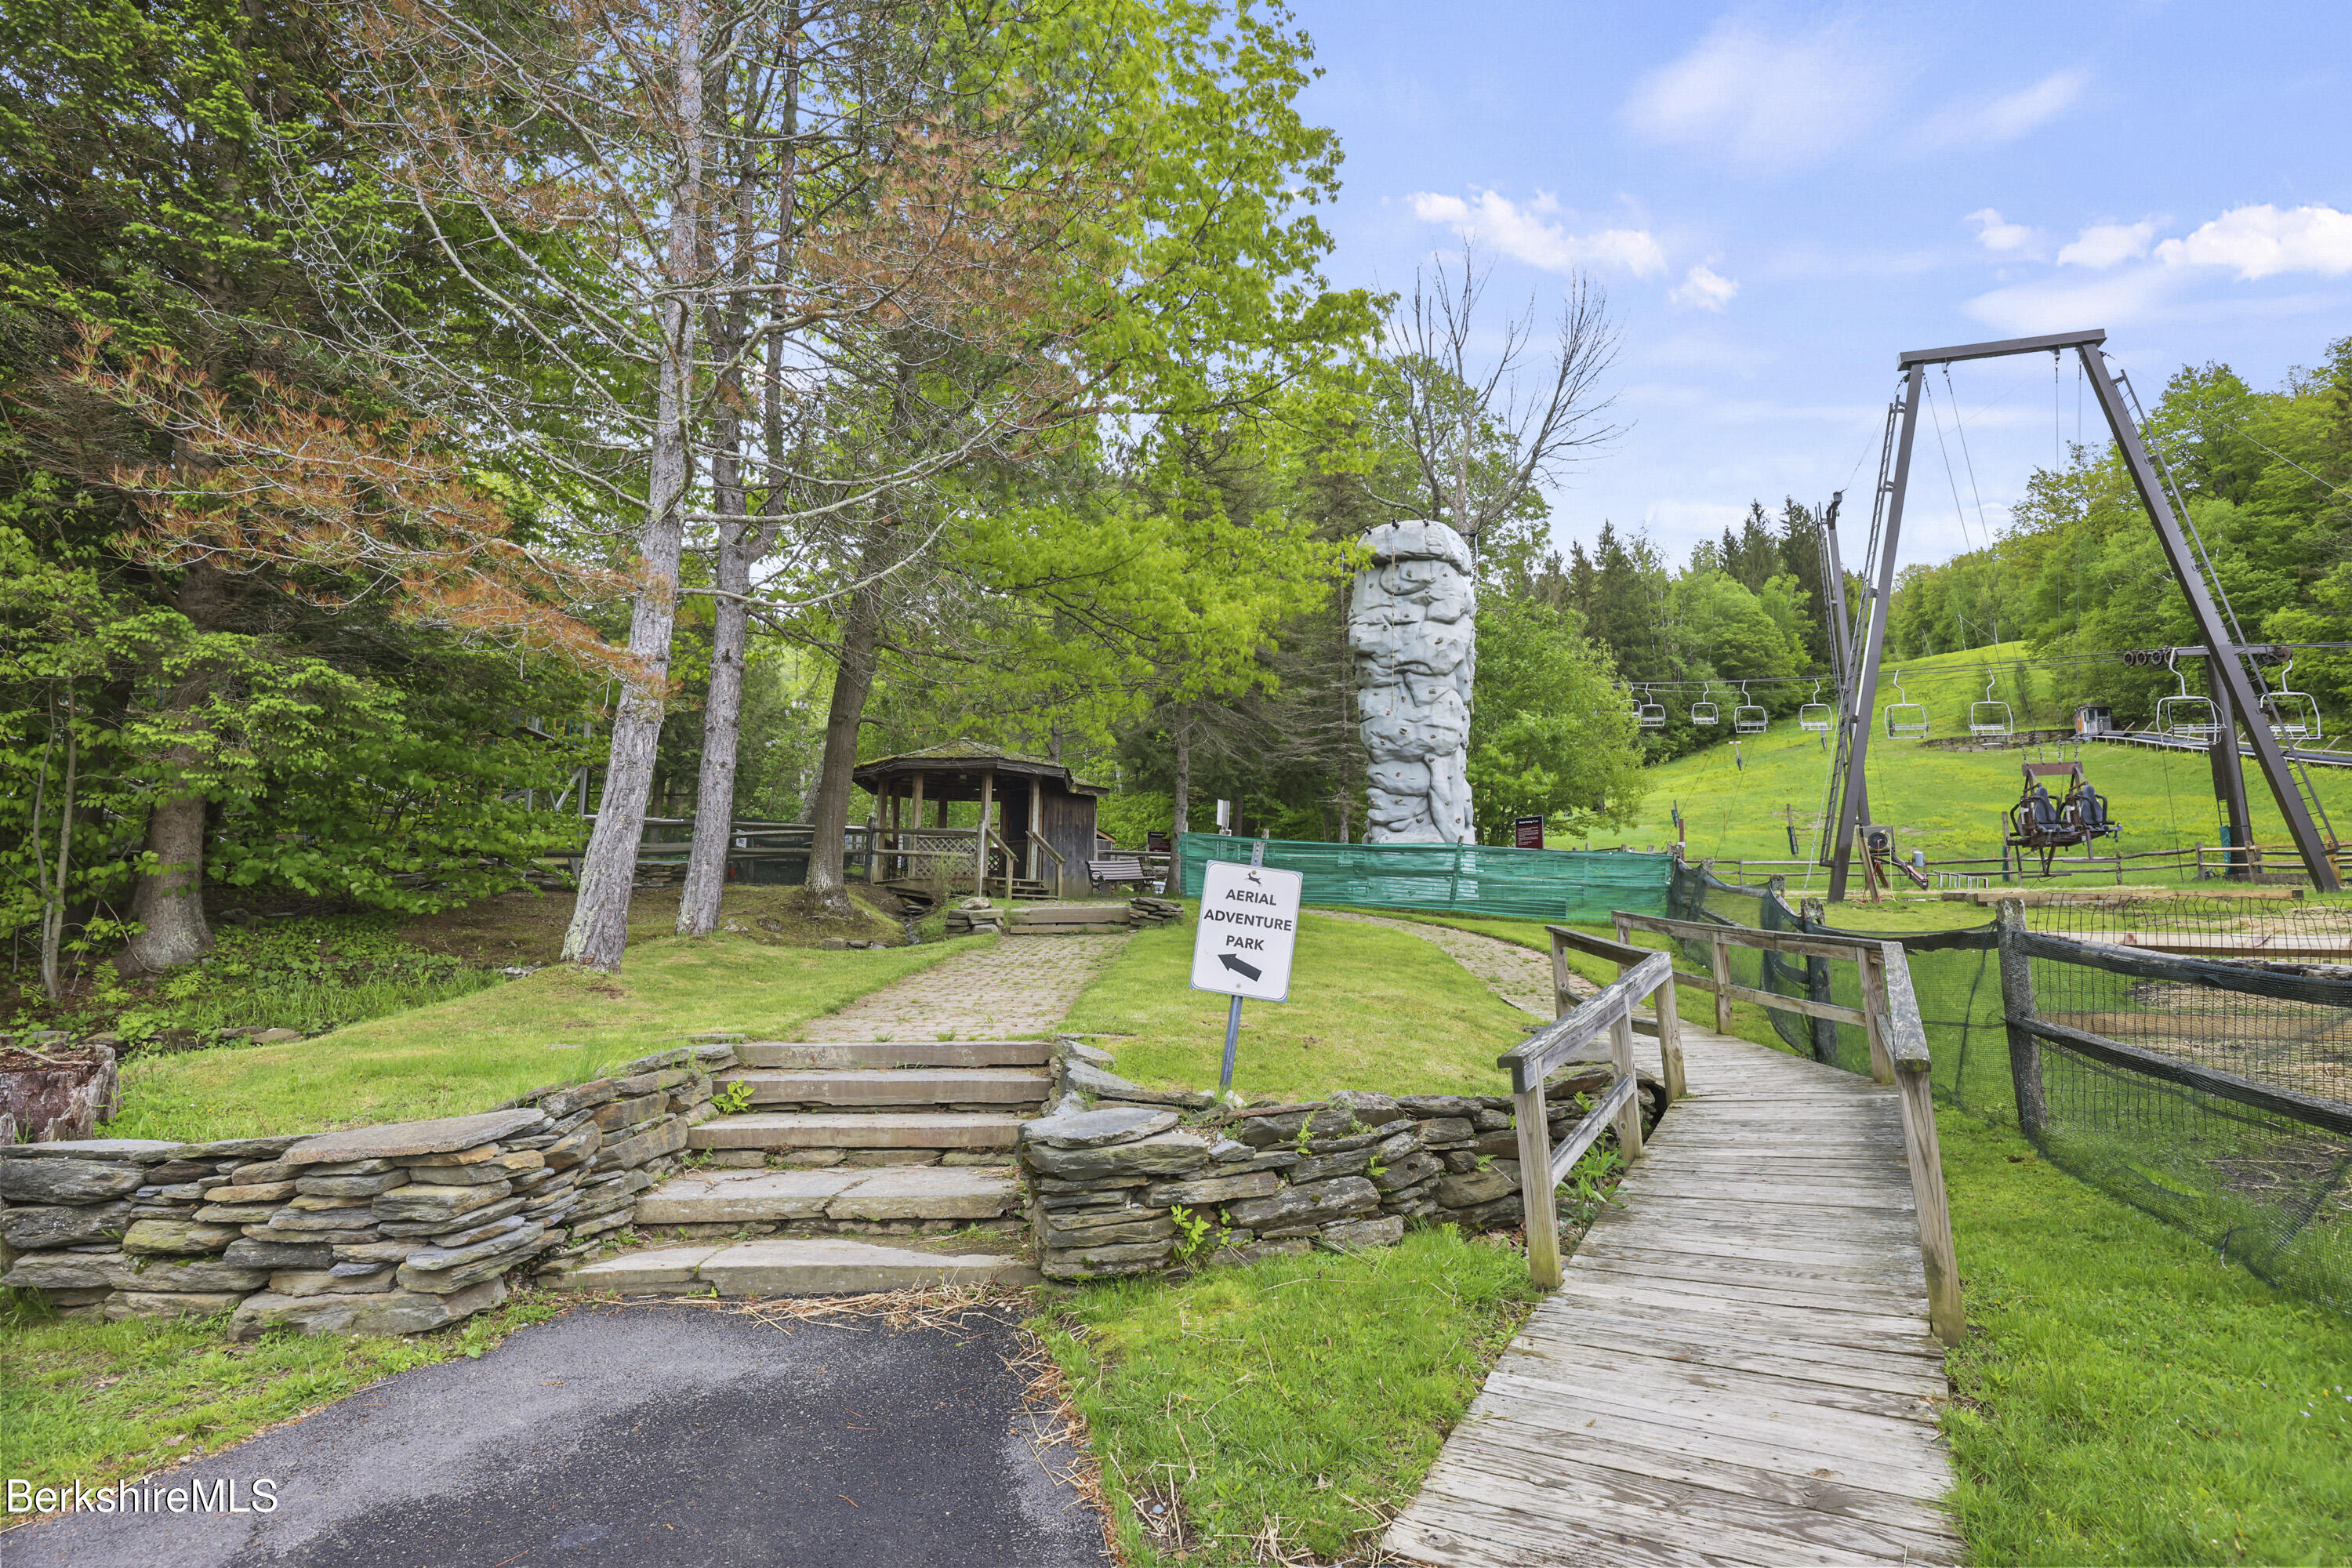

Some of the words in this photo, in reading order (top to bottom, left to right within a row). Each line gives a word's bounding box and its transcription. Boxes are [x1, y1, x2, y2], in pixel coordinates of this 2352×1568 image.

[1225, 889, 1276, 906] AERIAL
[1203, 909, 1292, 931] ADVENTURE
[1225, 935, 1264, 950] PARK
